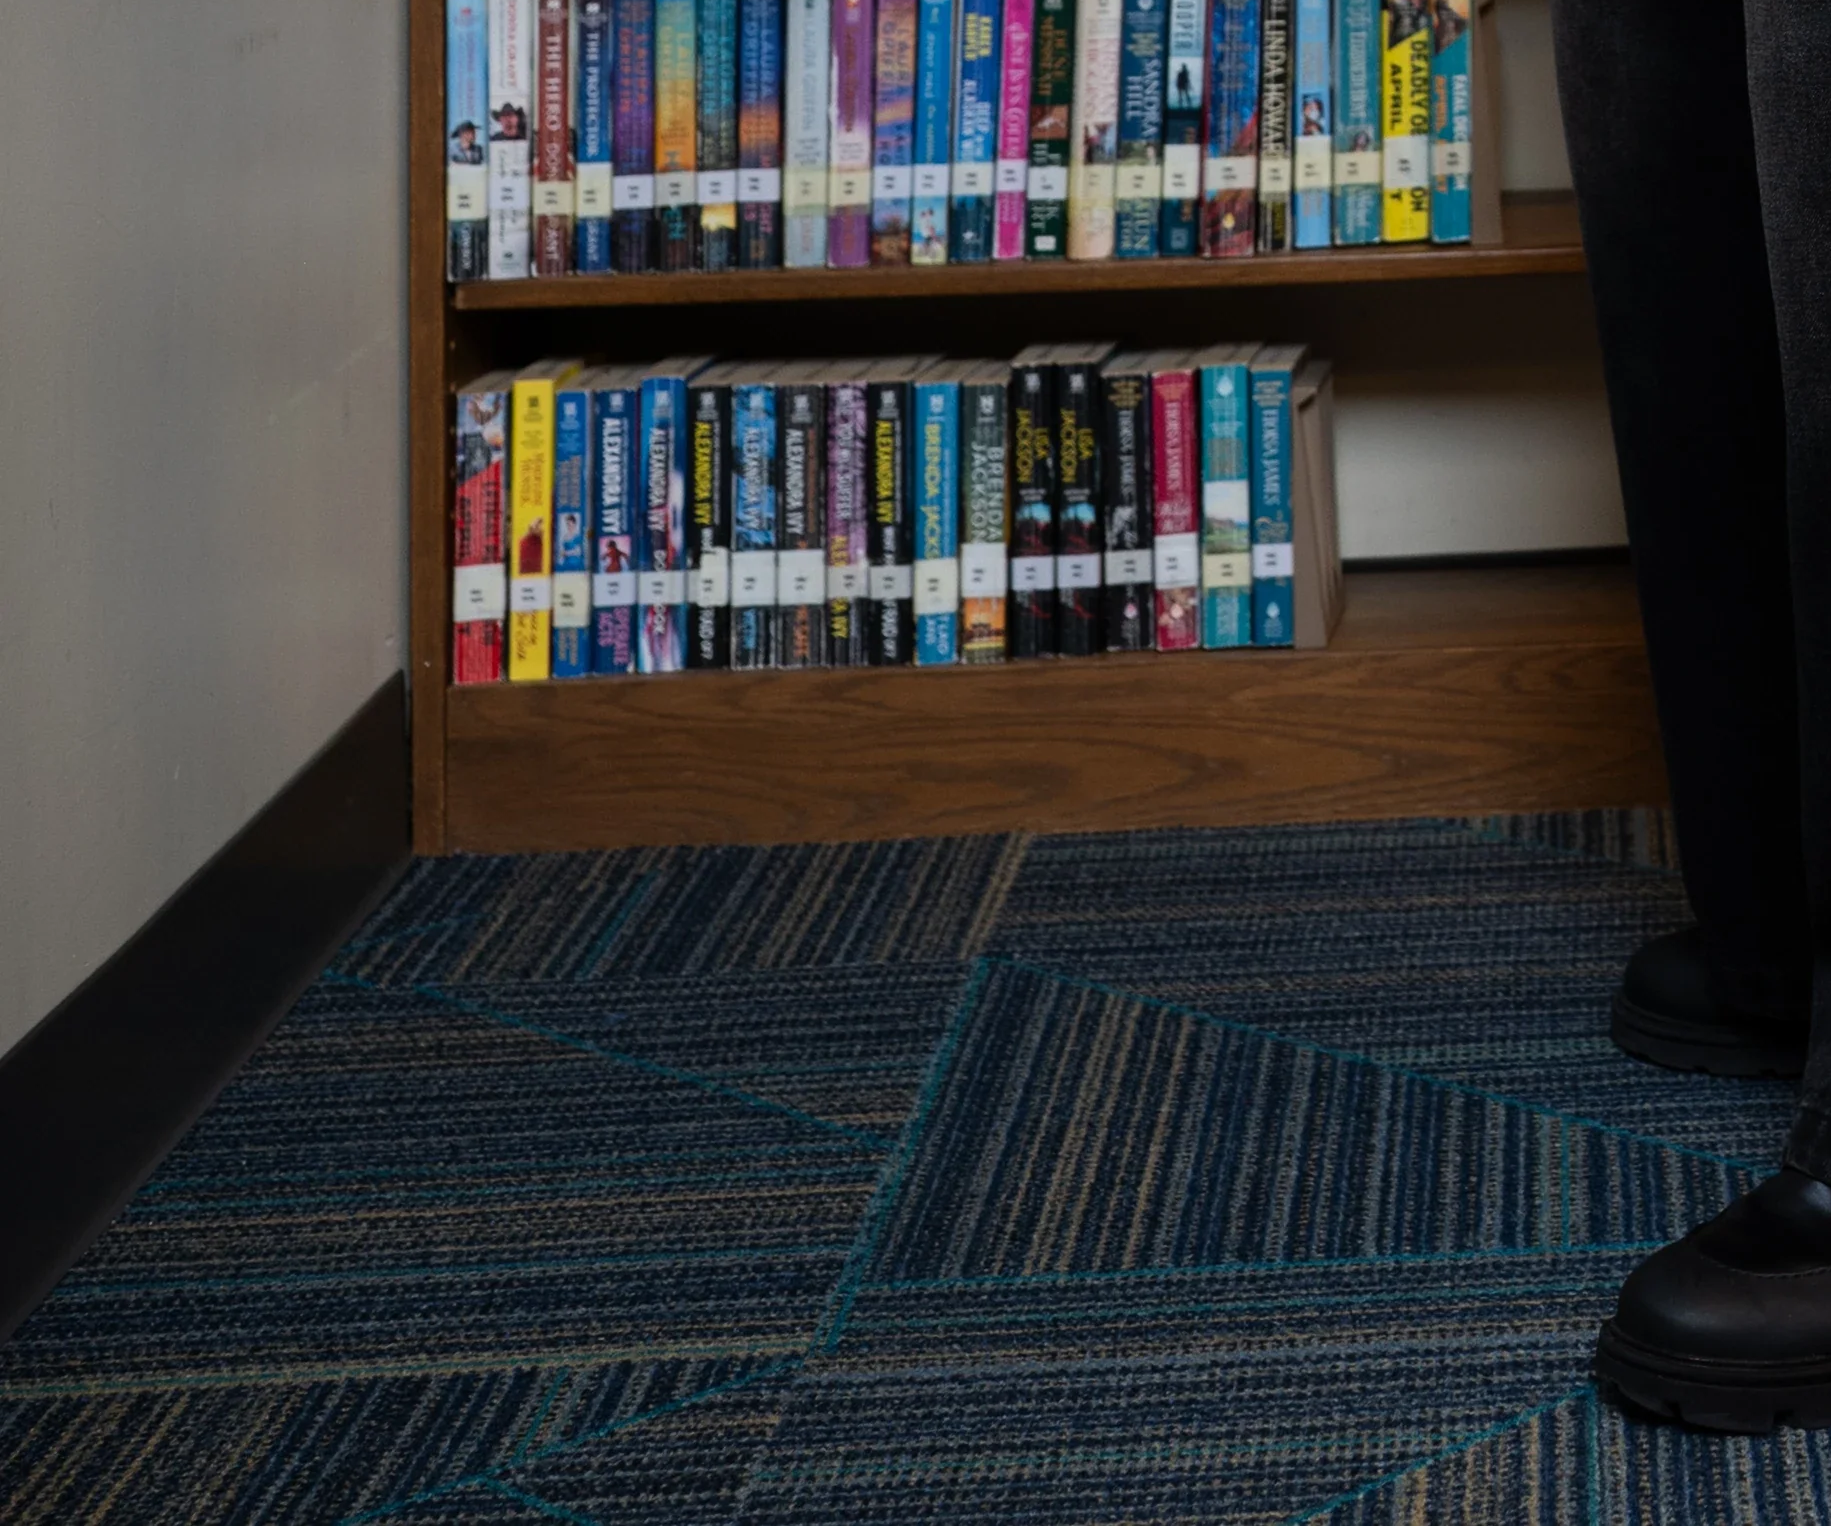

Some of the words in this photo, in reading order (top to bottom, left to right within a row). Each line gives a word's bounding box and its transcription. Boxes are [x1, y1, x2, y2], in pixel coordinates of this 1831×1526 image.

[545, 34, 560, 71] THE
[586, 32, 600, 61] THE
[1263, 19, 1285, 76] LINDA
[1410, 40, 1427, 106] DEADLY
[545, 78, 560, 130] HERO
[1127, 76, 1143, 120] HILL
[1144, 58, 1160, 133] SANDRA
[1263, 82, 1284, 158] HOWAR
[1390, 62, 1401, 129] APRIL
[694, 421, 711, 499] ALEXANDRA
[877, 421, 894, 498] ALEXANDRA
[924, 424, 941, 496] BRENDA
[1016, 409, 1033, 482] JACKSON
[1034, 429, 1049, 459] LISA
[1060, 409, 1077, 482] JACKSON
[1078, 429, 1093, 460] LISA
[1261, 410, 1281, 456] ELOISA
[602, 418, 619, 504] ALEXANDRA
[649, 427, 666, 505] ALEXANDRA
[743, 427, 762, 504] ALEXANDRA
[787, 429, 804, 508] ALEXANDRA
[1261, 460, 1281, 505] JAMES
[649, 508, 665, 532] IVY
[694, 503, 711, 525] IVY
[743, 507, 762, 530] IVY
[877, 502, 894, 523] IVY
[970, 442, 987, 543] JACKSON
[988, 447, 1004, 539] BRENDA
[602, 510, 620, 534] IVY
[787, 511, 804, 534] IVY
[921, 505, 941, 559] JACKS
[831, 617, 848, 638] IVY
